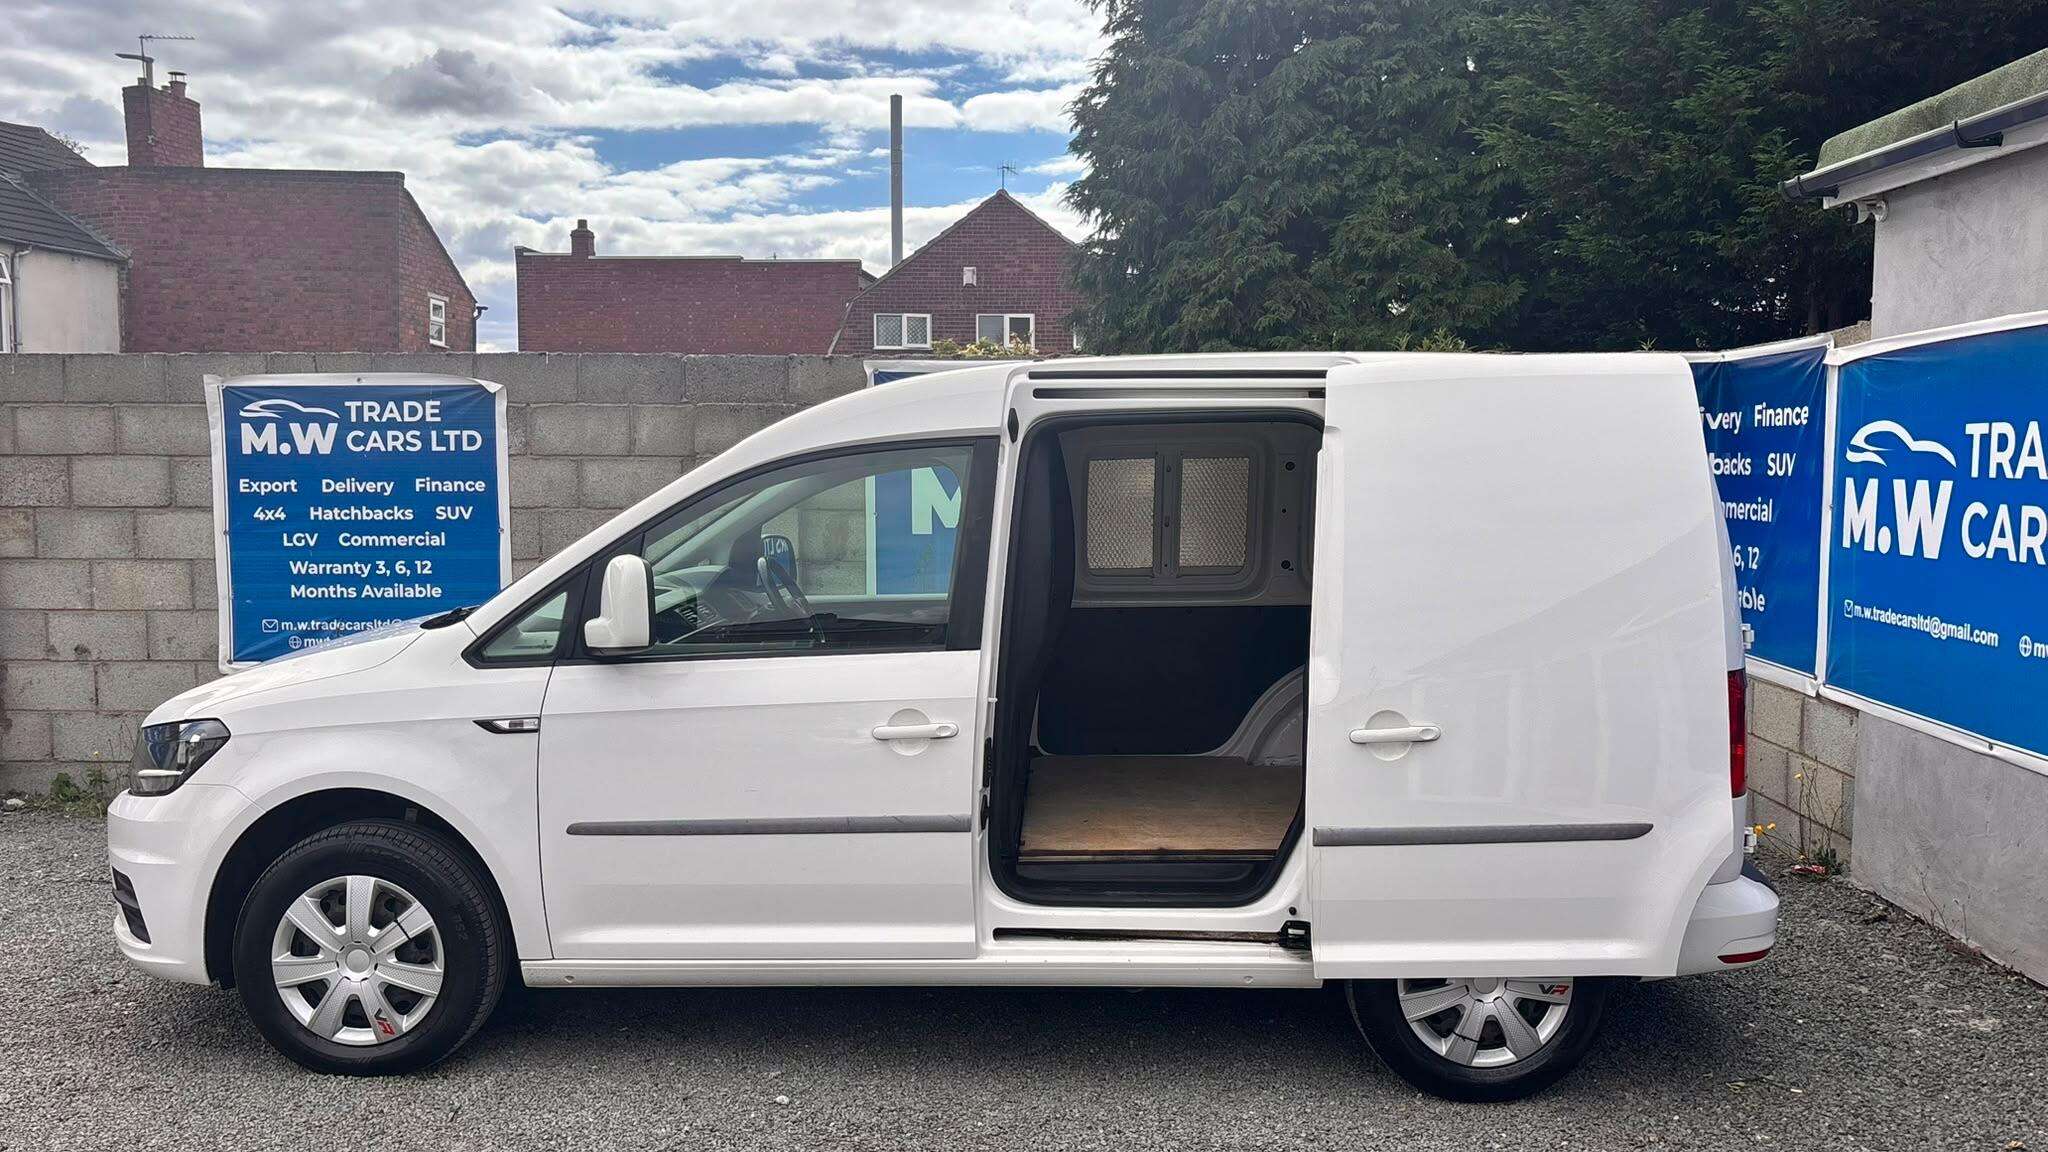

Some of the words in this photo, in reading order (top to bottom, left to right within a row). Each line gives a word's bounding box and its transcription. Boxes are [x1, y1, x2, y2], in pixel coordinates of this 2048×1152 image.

[344, 401, 441, 423] TRADE
[1754, 401, 1809, 428] Finance
[240, 422, 338, 455] M.W
[346, 430, 422, 452] CARS
[431, 430, 482, 451] LTD
[1965, 420, 2048, 480] TRA
[1767, 452, 1796, 477] SUV
[239, 478, 297, 495] Export
[321, 478, 394, 496] Delivery
[415, 477, 486, 492] Finance
[253, 506, 287, 520] 4x4
[310, 506, 414, 520] Hatchbacks
[435, 505, 473, 520] SUV
[1842, 477, 1953, 560] M.W
[283, 532, 318, 547] LGV
[338, 531, 446, 547] Commercial
[1961, 501, 2048, 566] CAR
[289, 560, 371, 578] Warranty
[375, 561, 391, 576] 3,
[395, 561, 411, 576] 6,
[415, 560, 432, 575] 12
[1747, 546, 1760, 570] 12
[290, 584, 357, 598] Months
[361, 583, 442, 598] Available
[1854, 603, 1999, 648] m.w.tradecarsltd@gmail.com
